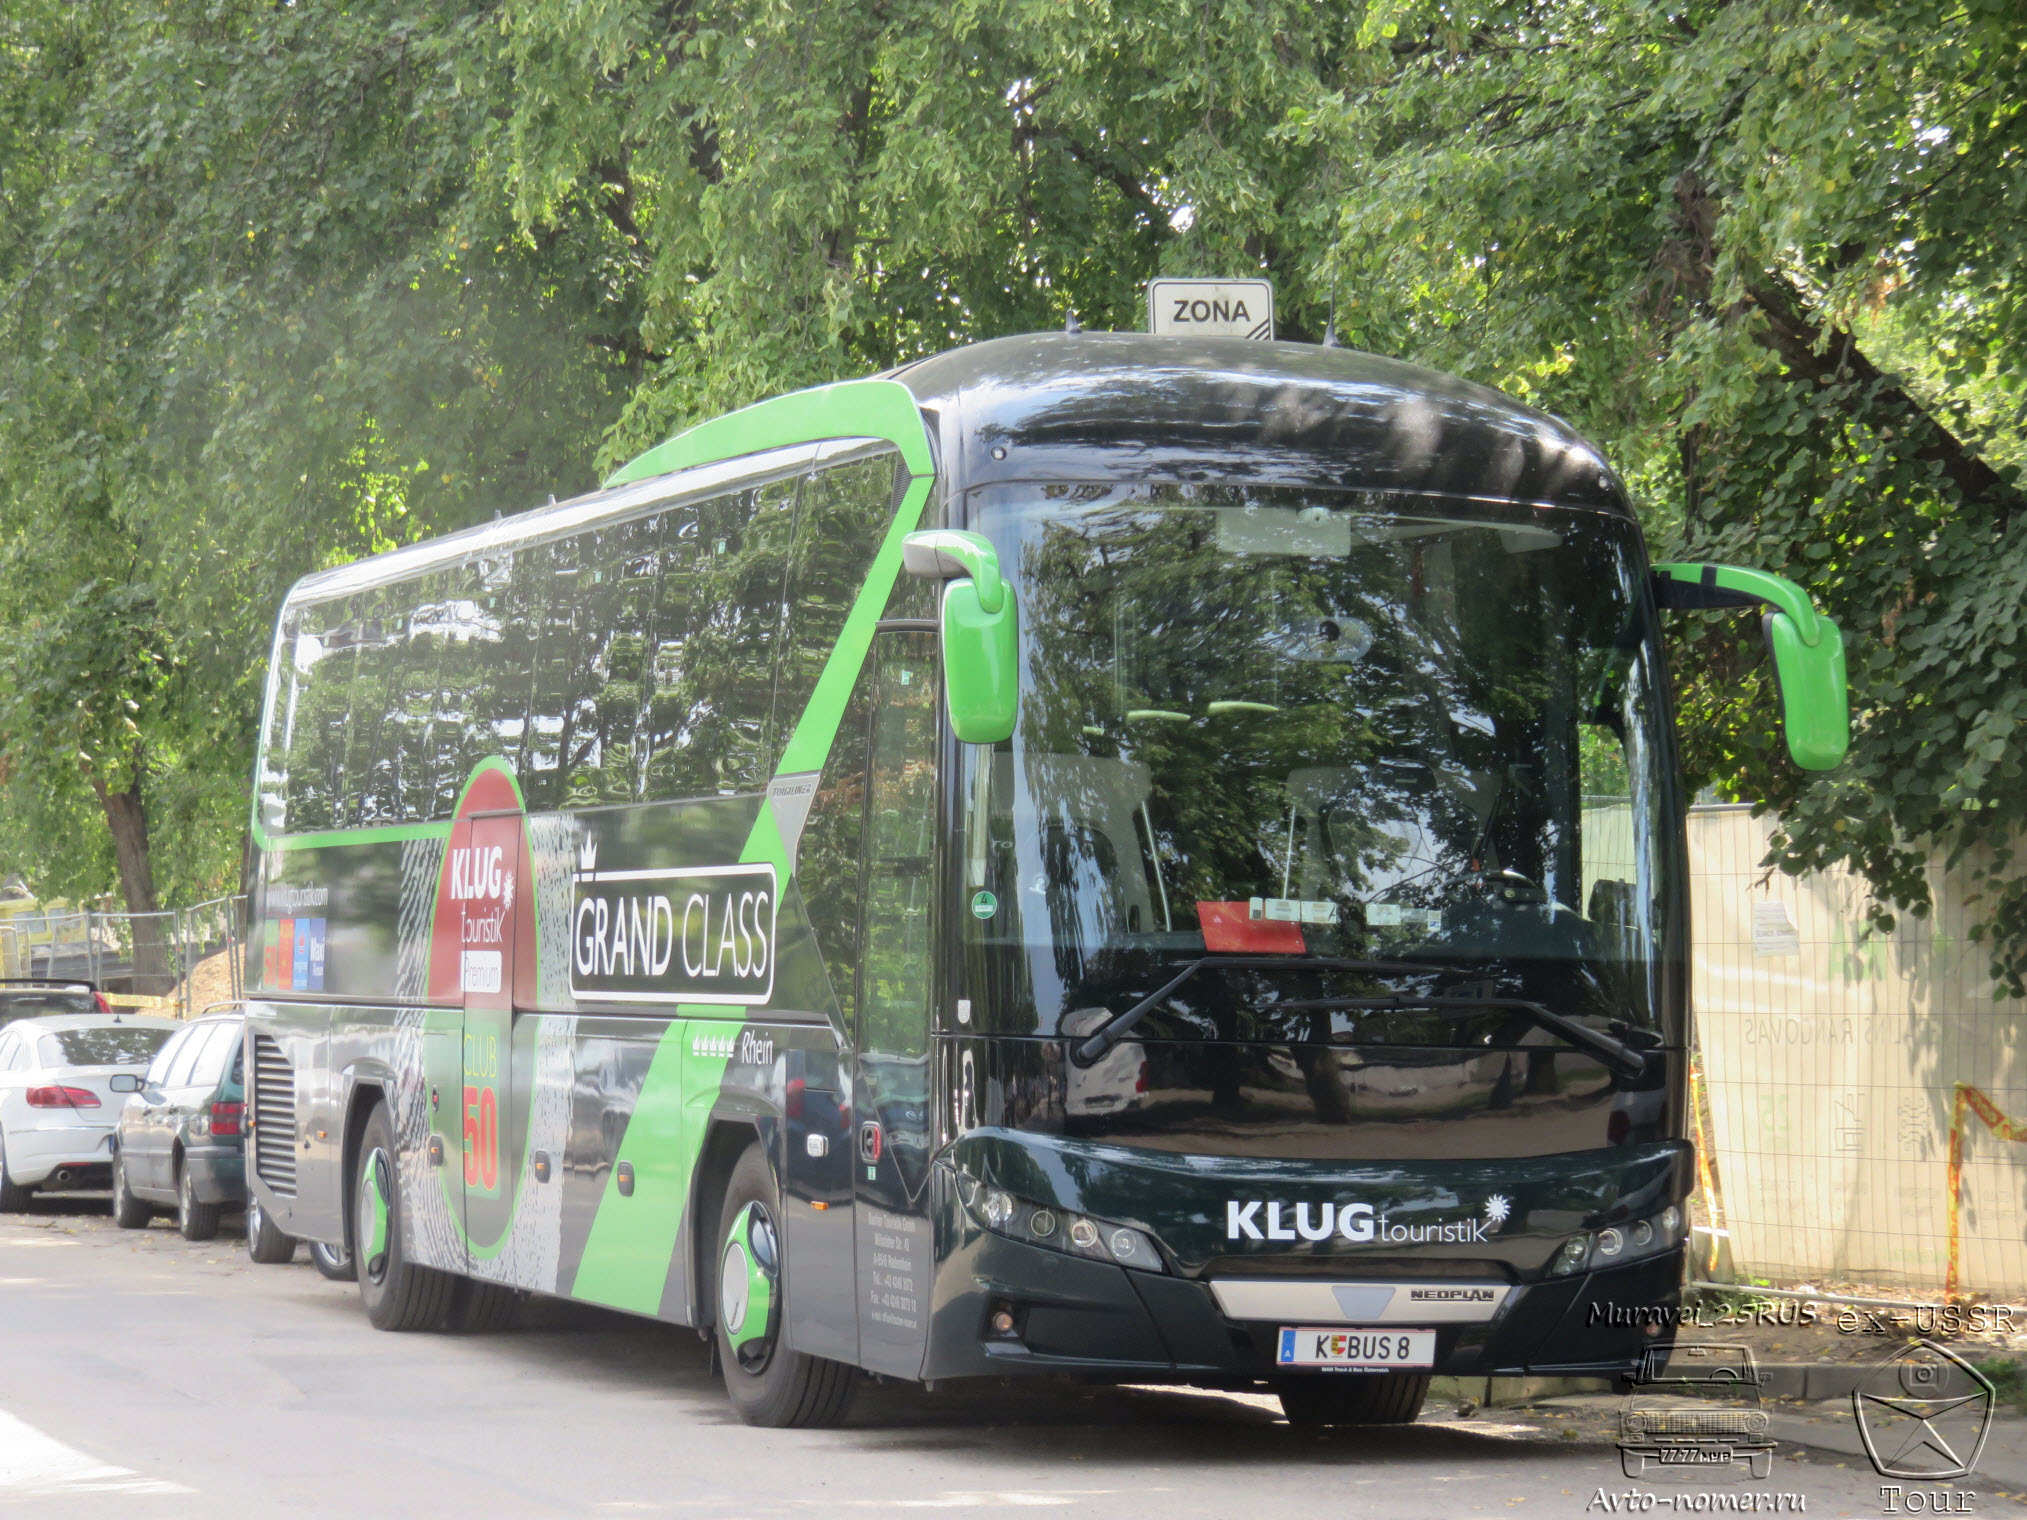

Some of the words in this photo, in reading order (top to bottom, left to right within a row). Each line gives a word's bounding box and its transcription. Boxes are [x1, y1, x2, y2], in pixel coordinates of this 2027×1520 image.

[1173, 299, 1251, 322] ZONA
[772, 783, 812, 797] TOURLINER
[450, 846, 503, 899] KLUG
[980, 893, 989, 904] 4
[461, 902, 503, 943] touristik
[575, 895, 674, 977] GRAND
[682, 890, 769, 979] CLASS
[463, 953, 500, 988] Premium
[463, 1033, 497, 1079] CLUB
[741, 1029, 774, 1065] Rhein
[463, 1085, 498, 1191] 50
[1227, 1200, 1374, 1242] KLUG
[1377, 1212, 1492, 1243] touristik
[1410, 1289, 1495, 1301] NEOPLAN
[1284, 1349, 1291, 1358] A
[1315, 1334, 1330, 1359] K
[1347, 1335, 1391, 1360] BUS
[1397, 1336, 1410, 1360] 8
